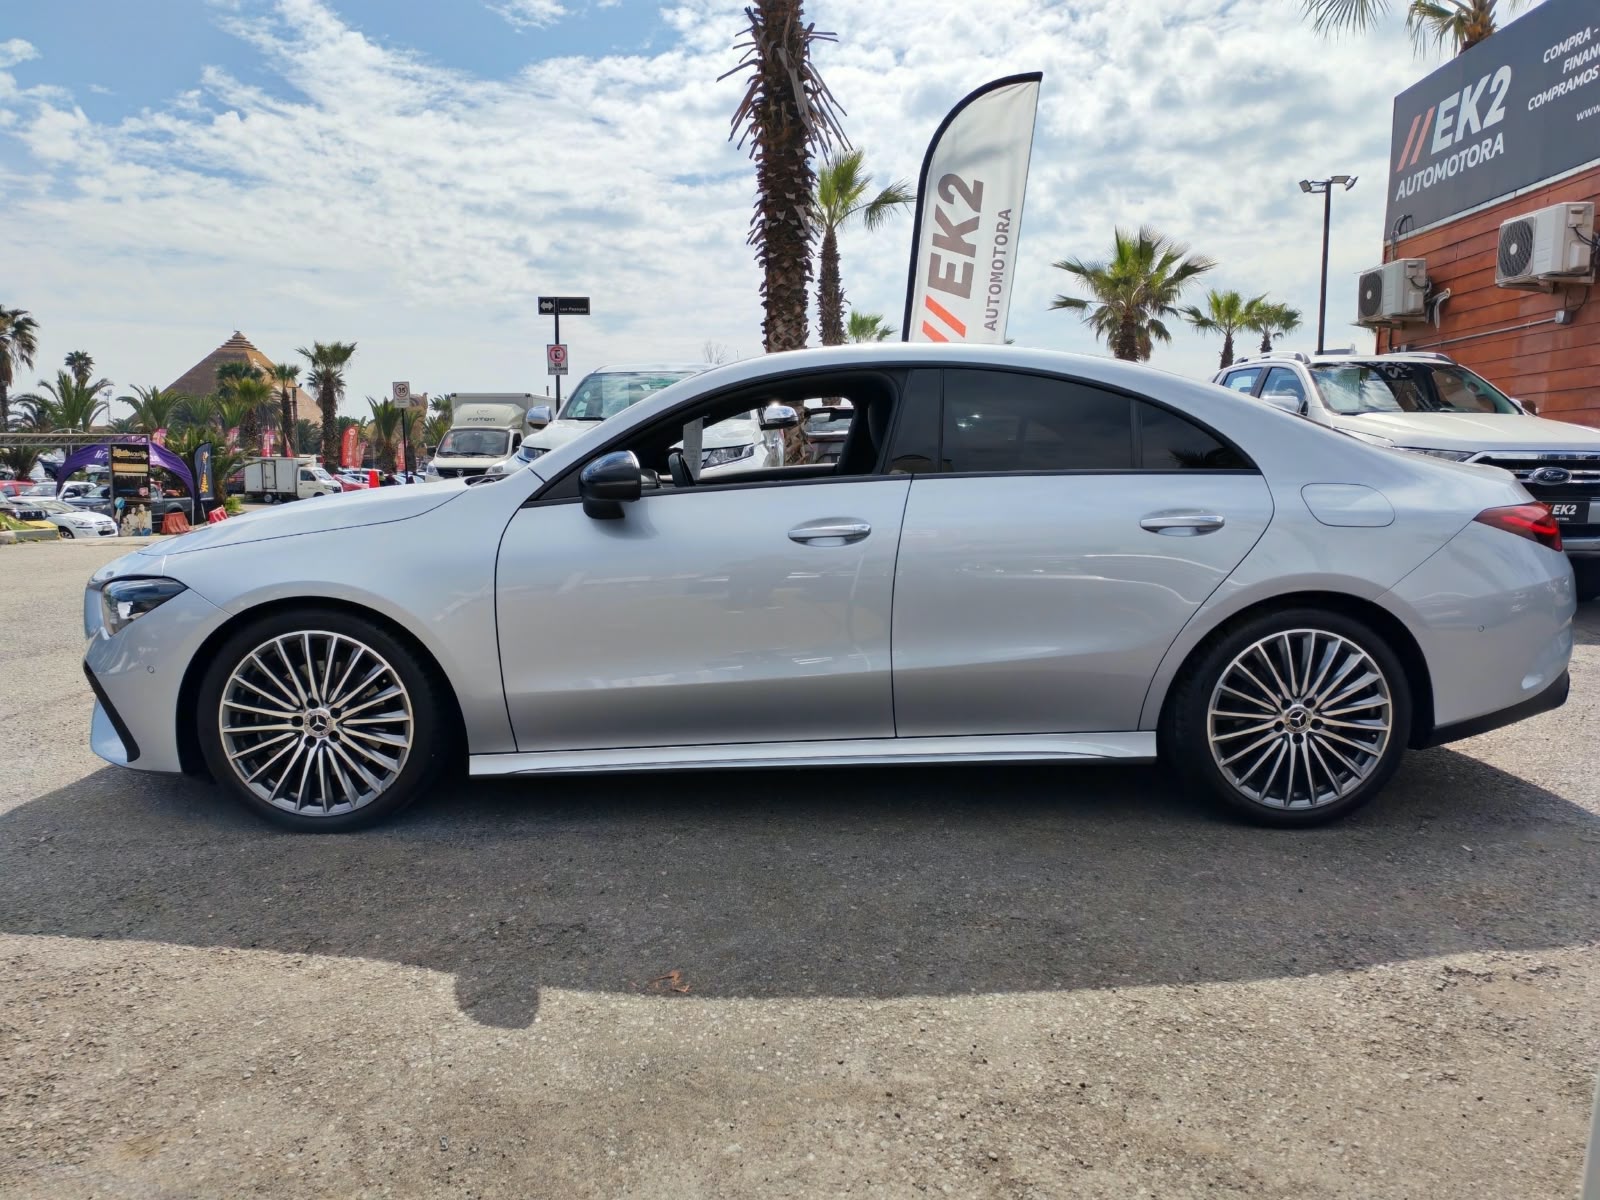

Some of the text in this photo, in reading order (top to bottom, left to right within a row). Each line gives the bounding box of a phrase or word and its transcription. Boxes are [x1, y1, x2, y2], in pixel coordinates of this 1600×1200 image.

[1543, 26, 1591, 63] COMPRA
[1563, 42, 1600, 74] FINAN
[1528, 64, 1600, 111] COMPRAMOS
[1395, 132, 1504, 201] AUTOMOTORA
[984, 208, 1012, 332] AUTOMOTORA
